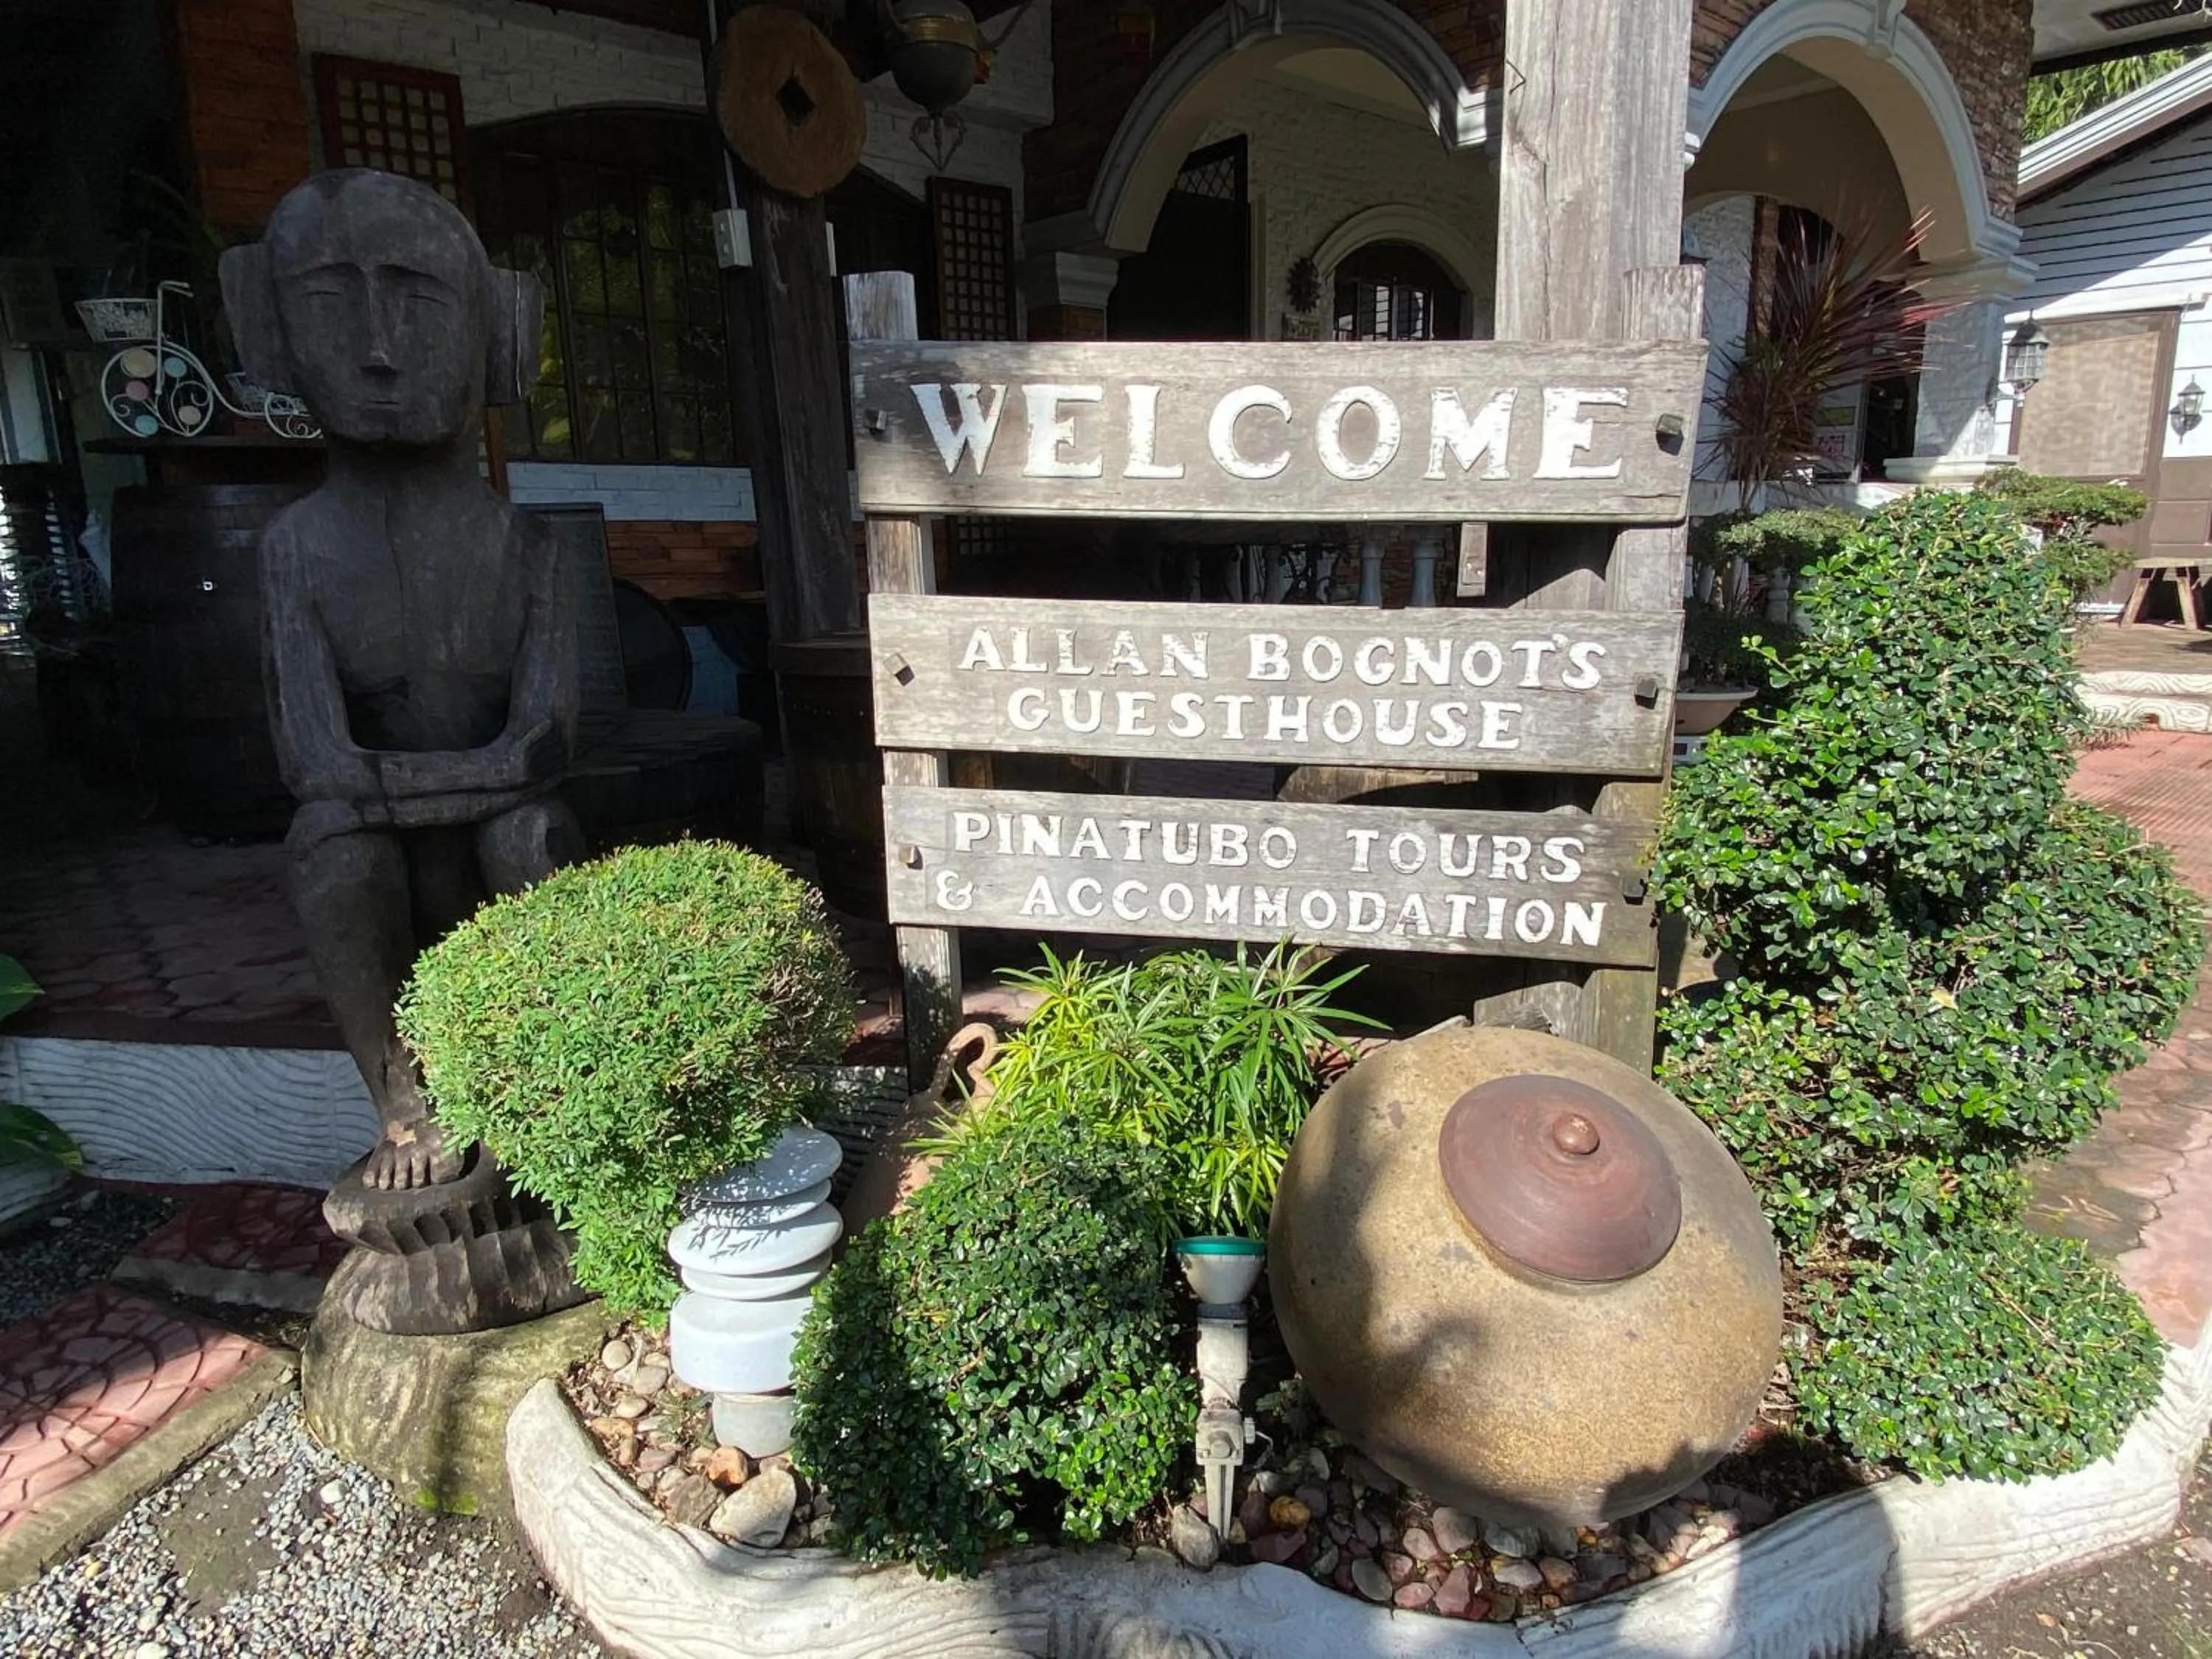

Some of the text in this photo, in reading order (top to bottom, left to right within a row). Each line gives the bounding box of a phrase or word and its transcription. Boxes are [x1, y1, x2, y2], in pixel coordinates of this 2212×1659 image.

[910, 383, 1629, 480] WELCOME
[957, 625, 1607, 689] ALLAN BOGNOT'S
[1006, 688, 1523, 751] GUESTHOUSE
[952, 811, 1585, 883] PINATUBO TOURS
[935, 869, 1607, 947] & ACCOMMODATION
